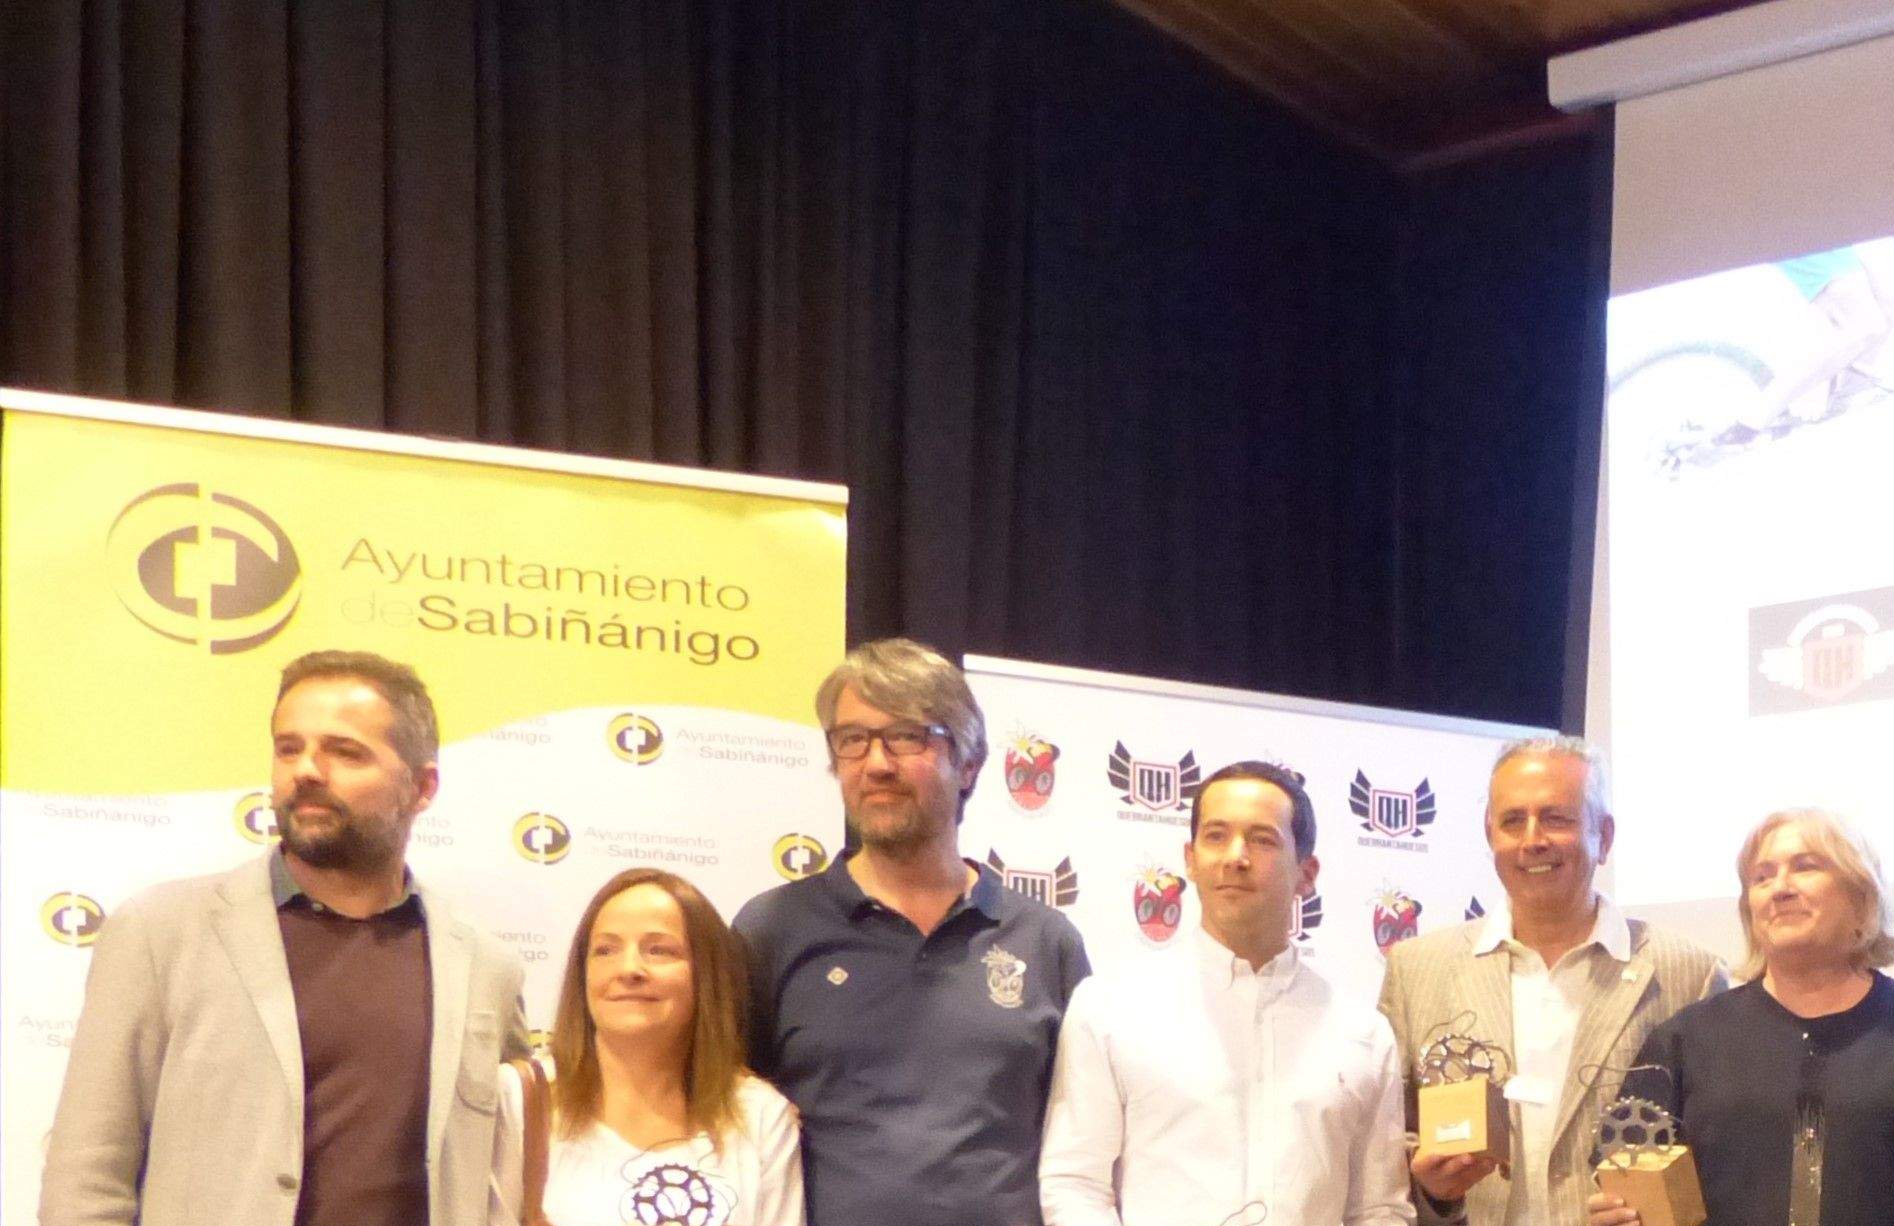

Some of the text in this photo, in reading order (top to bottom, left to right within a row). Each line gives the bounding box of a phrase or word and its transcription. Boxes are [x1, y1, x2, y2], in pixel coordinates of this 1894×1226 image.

[341, 537, 750, 612] Ayuntamiento
[417, 593, 761, 667] Sabiñánigo
[676, 728, 806, 751] Ayuntamiento
[699, 745, 809, 769] Sabiñánigo
[584, 826, 717, 849] Ayuntamiento
[607, 844, 720, 867] Sabiñánigo
